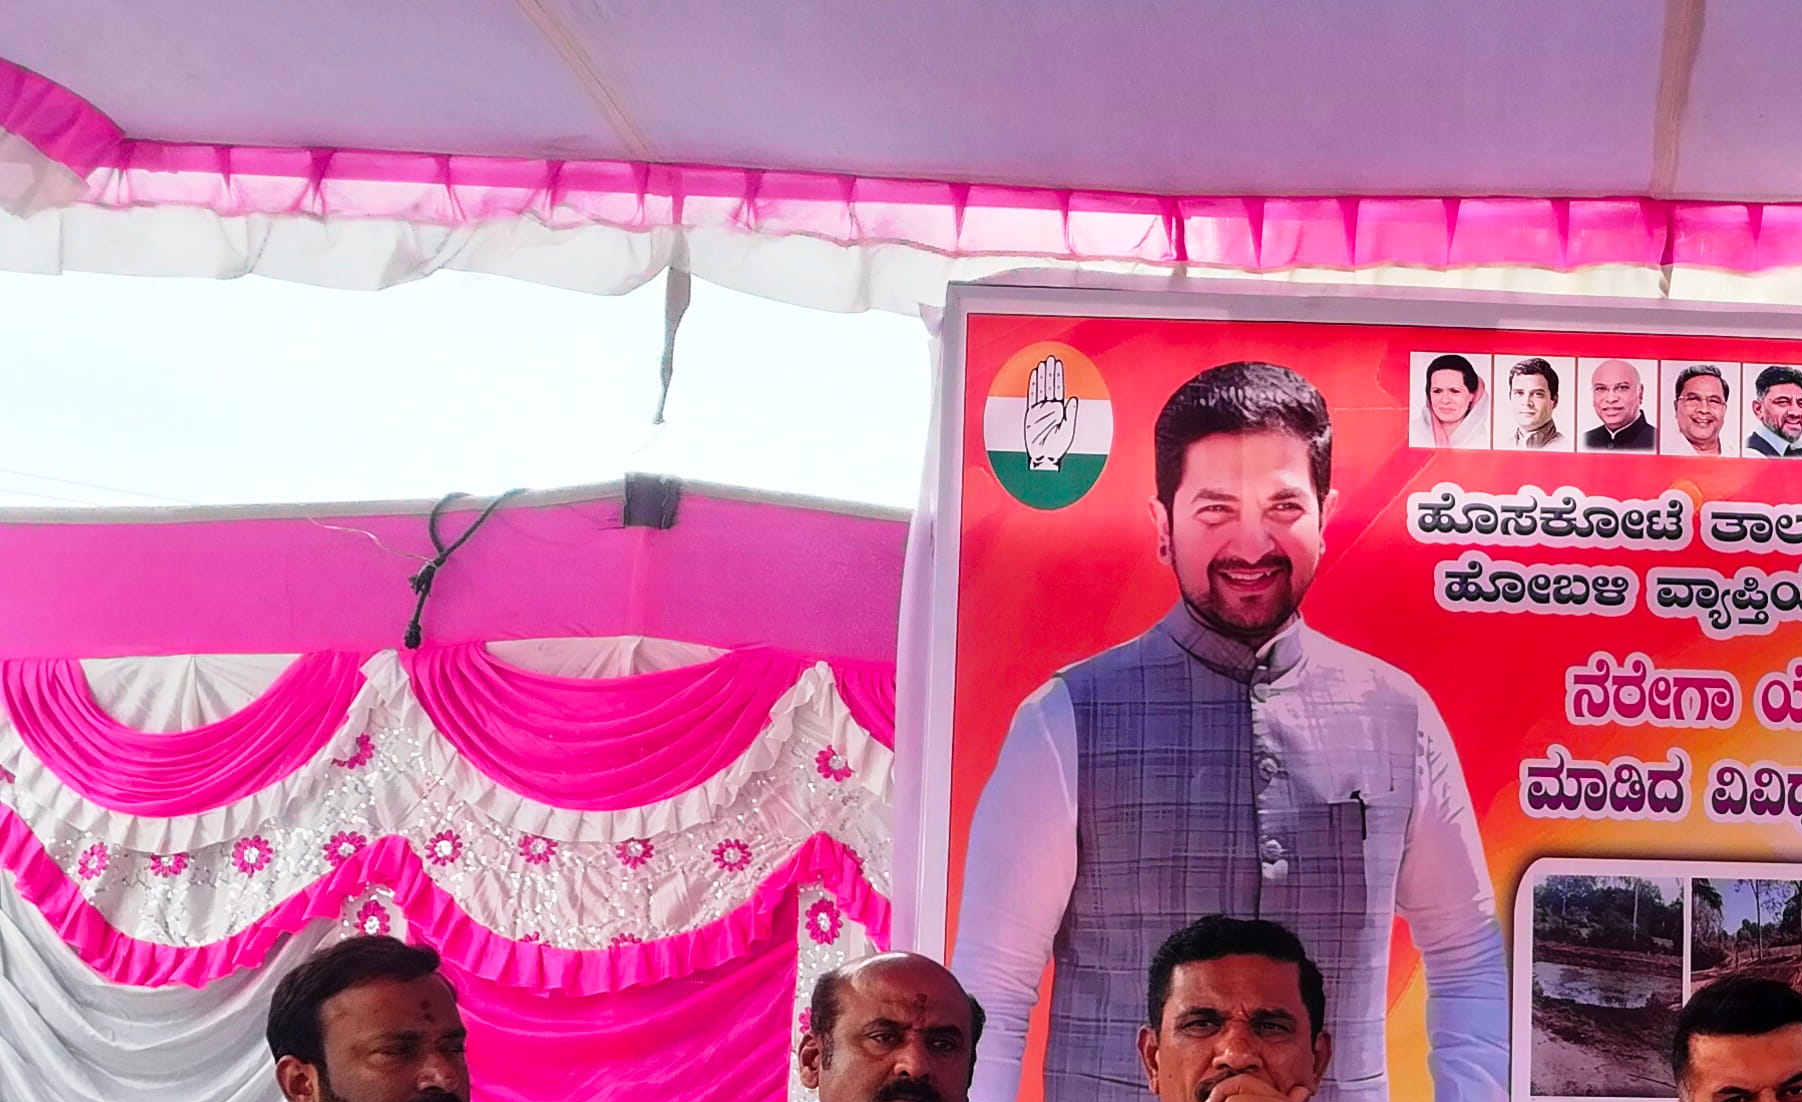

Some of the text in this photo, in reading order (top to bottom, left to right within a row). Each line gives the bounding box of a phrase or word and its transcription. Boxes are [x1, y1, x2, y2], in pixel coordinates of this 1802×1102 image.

[1417, 492, 1684, 540] ಹೊಸಕೋಟೆ
[1444, 560, 1630, 606] ಹೋಬಳಿ
[1573, 658, 1735, 722] ನೆರೇಗಾ
[1527, 750, 1685, 814] ಮಾಡಿದ
